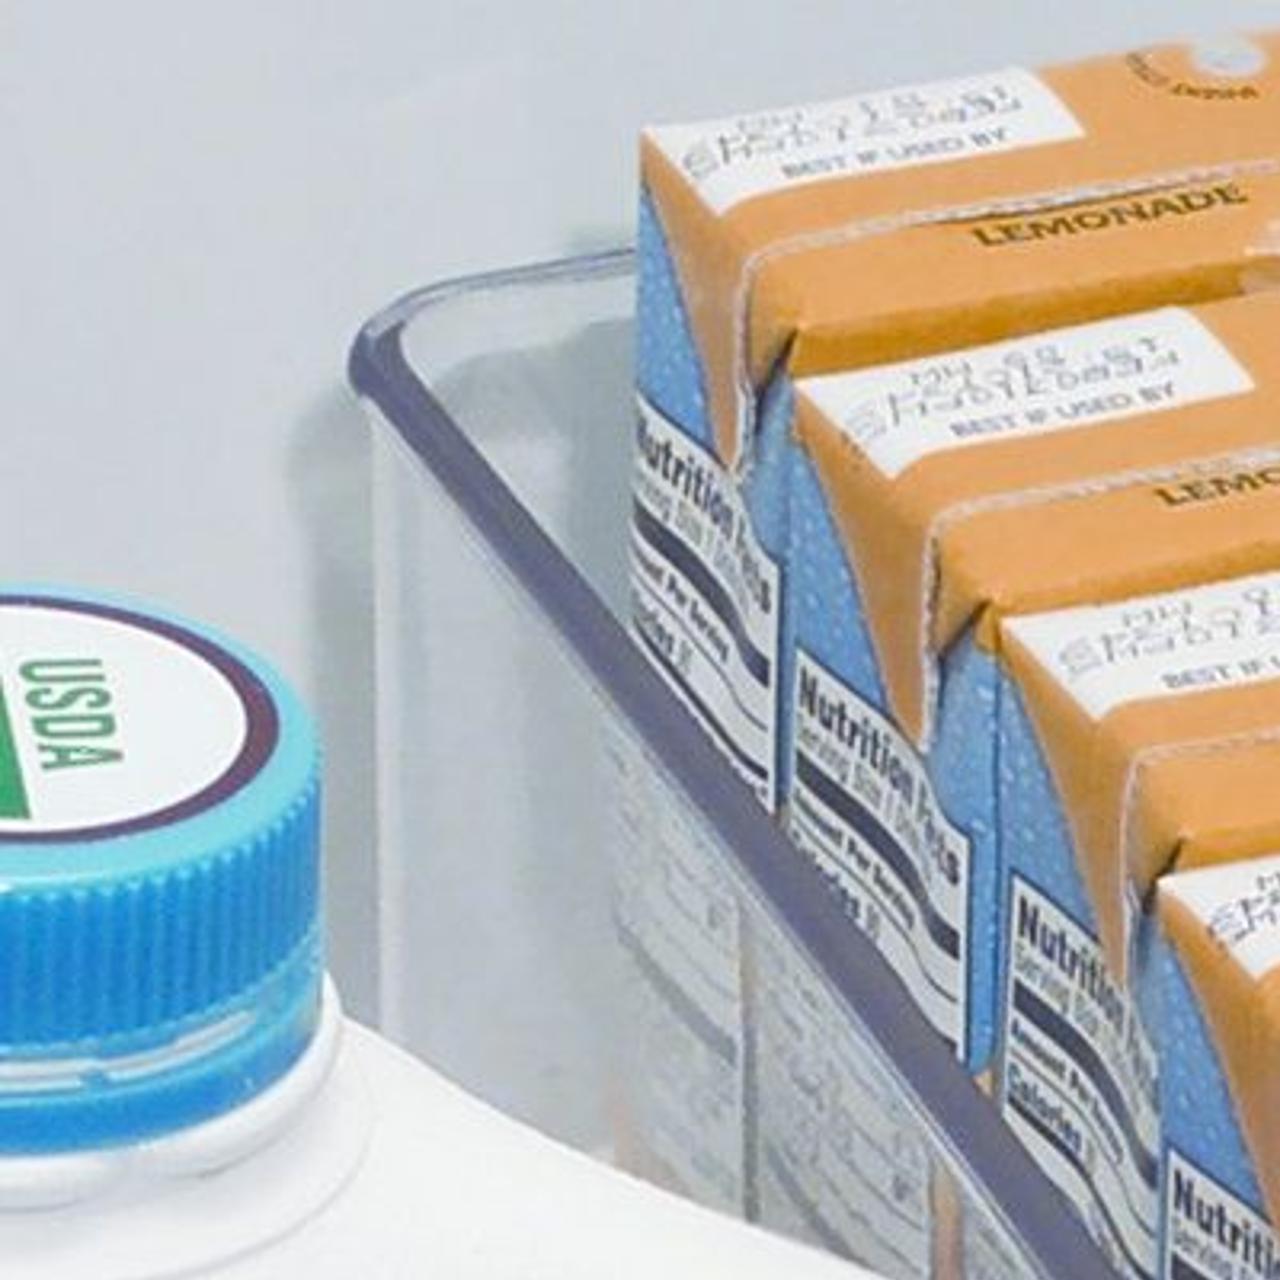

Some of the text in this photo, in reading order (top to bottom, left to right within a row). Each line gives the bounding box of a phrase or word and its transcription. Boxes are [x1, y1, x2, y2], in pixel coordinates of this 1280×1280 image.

[969, 184, 1248, 246] LEMONADE
[18, 658, 125, 770] USDA
[1162, 663, 1230, 690] BEST
[799, 663, 915, 798] Nutrition
